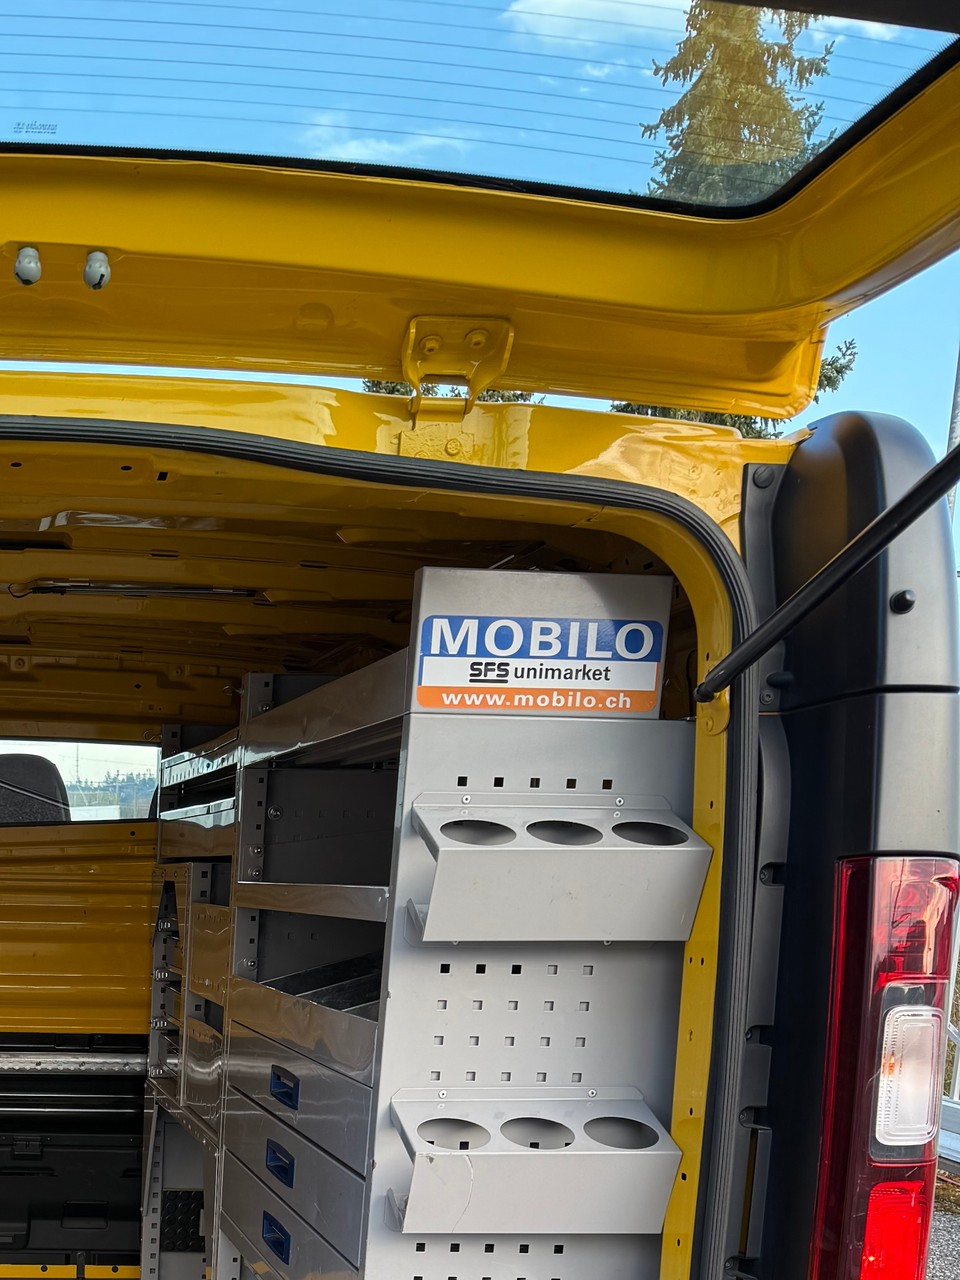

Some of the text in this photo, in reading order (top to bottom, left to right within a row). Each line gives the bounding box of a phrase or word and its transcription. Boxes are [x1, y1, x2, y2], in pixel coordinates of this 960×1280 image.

[430, 618, 654, 660] MOBILO
[469, 661, 611, 682] SFS unimarket
[442, 691, 631, 709] www.mobilo.ch
